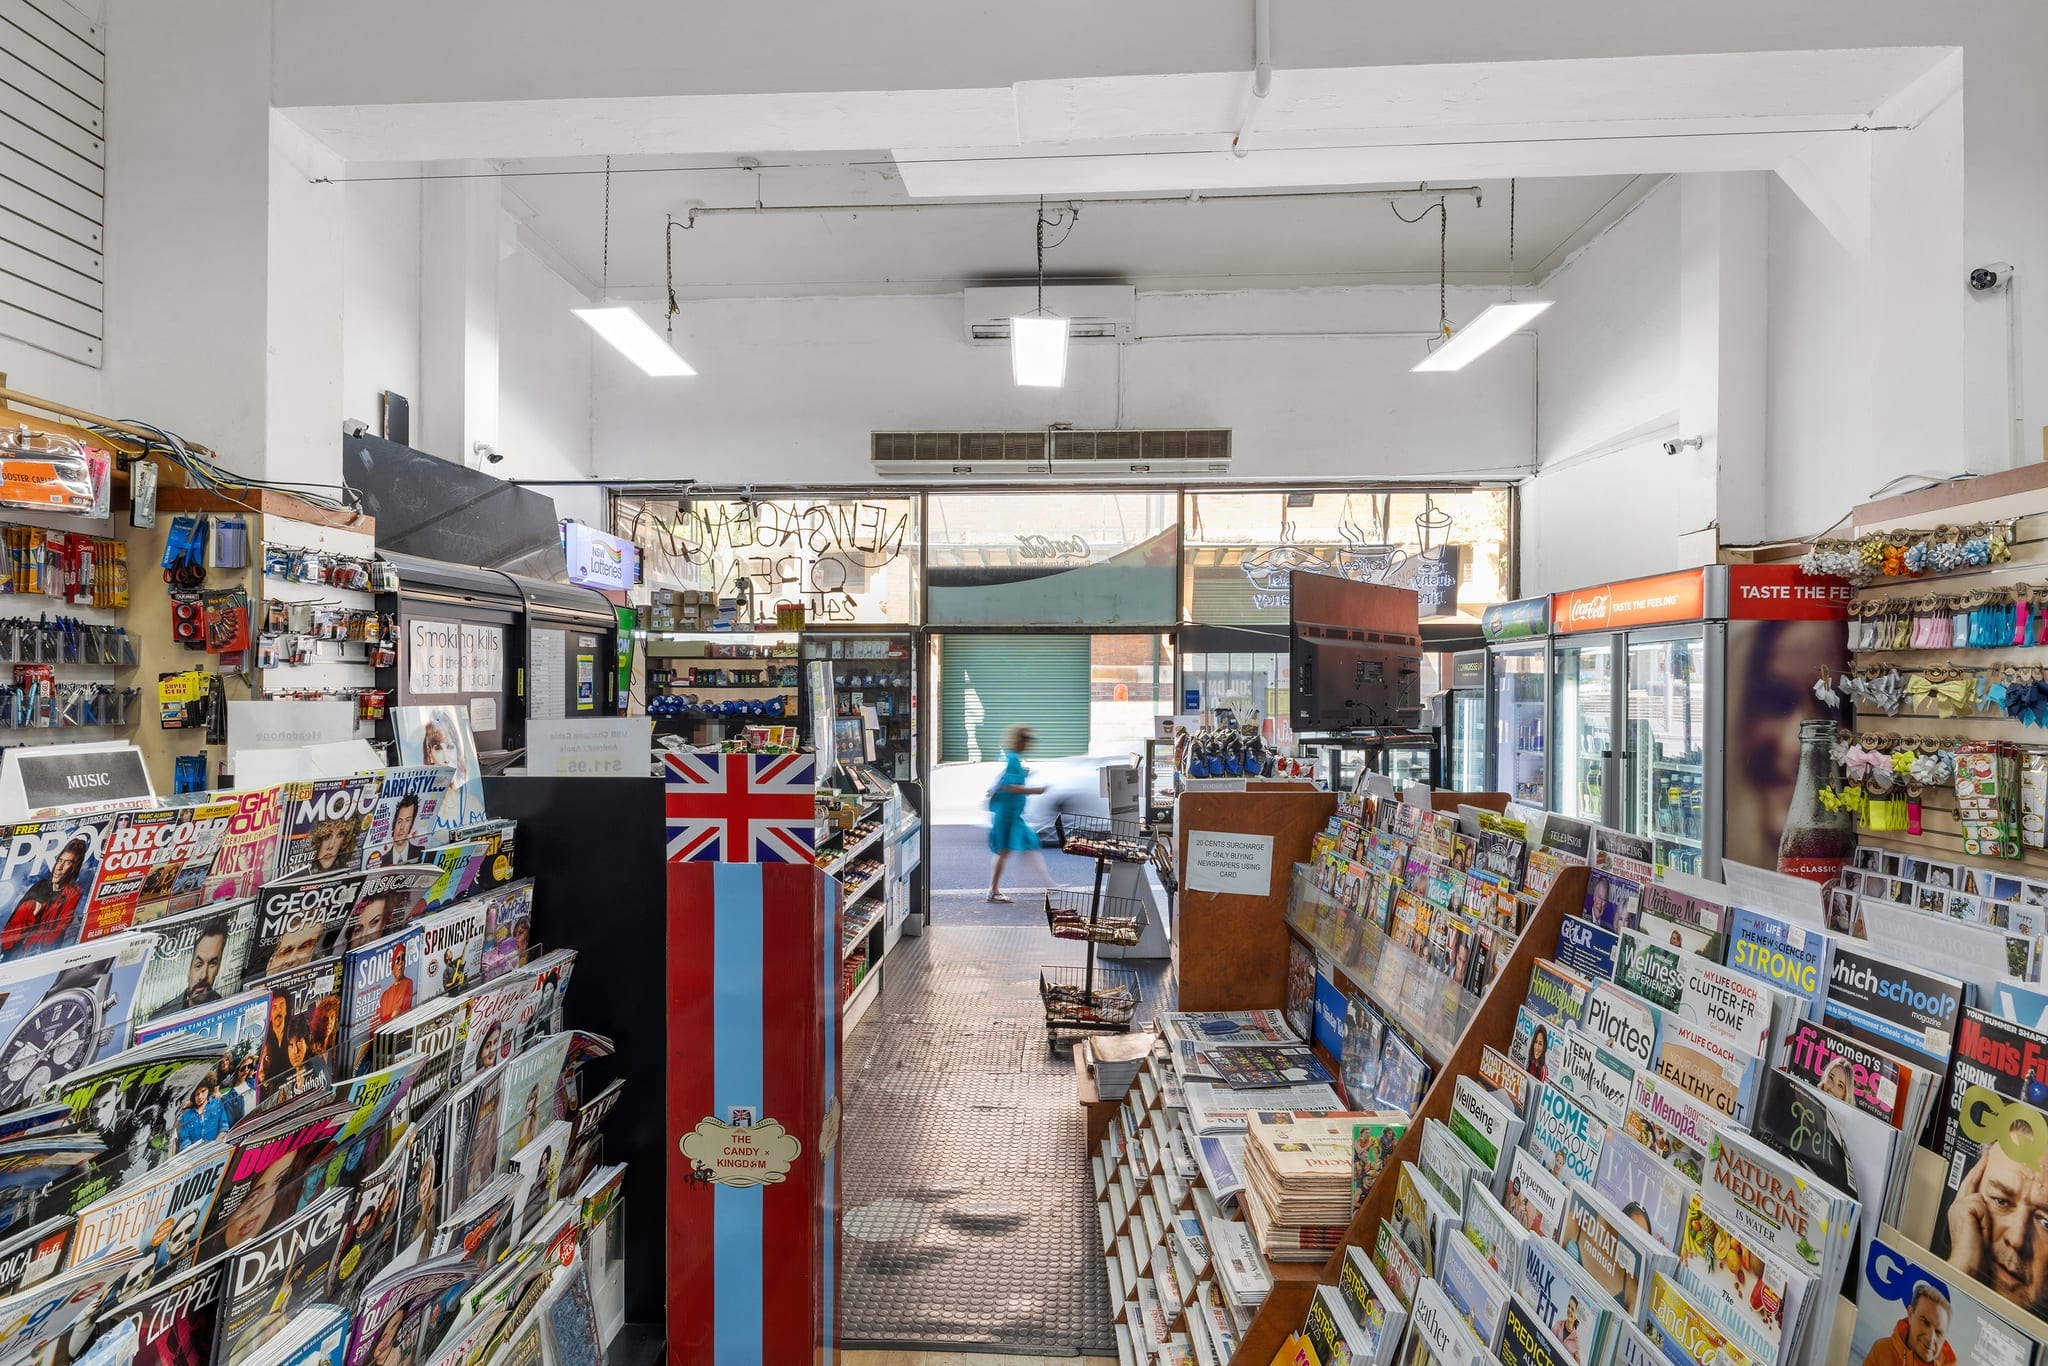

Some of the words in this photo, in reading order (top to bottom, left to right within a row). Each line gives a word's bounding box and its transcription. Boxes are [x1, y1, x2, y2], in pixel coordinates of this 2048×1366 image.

[592, 545, 605, 558] NSW
[590, 559, 622, 580] Lotteries
[1740, 586, 1791, 599] TASTE
[1794, 586, 1825, 599] THE
[1571, 595, 1607, 622] Coca-Cola
[1613, 602, 1633, 612] TASTE
[1632, 600, 1646, 610] THE
[1646, 595, 1680, 609] FEELING
[417, 626, 474, 654] Smoking
[478, 629, 498, 651] kills
[67, 773, 110, 789] MUSIC
[381, 778, 410, 799] ARRY
[295, 784, 379, 825] MOJO
[15, 824, 40, 834] FREE
[110, 819, 229, 852] RECORD
[1550, 829, 1582, 849] TELEVISION
[1212, 852, 1229, 860] ONLY
[1230, 853, 1254, 861] BUYING
[1226, 841, 1265, 851] SURCHARGE
[437, 853, 471, 874] BEATLES
[1198, 860, 1240, 870] NEWSPAPERS
[1241, 862, 1261, 871] USING
[1220, 871, 1237, 879] CARD
[1613, 856, 1624, 867] FIRE
[1626, 860, 1652, 877] STATION
[101, 880, 140, 896] Britpop
[1646, 887, 1683, 917] Vintage
[260, 903, 350, 938] MICHAEL
[1753, 919, 1765, 930] MY
[1765, 923, 1782, 937] LIFE
[1741, 929, 1756, 942] THE
[1756, 933, 1774, 947] NEW
[1774, 938, 1804, 960] SCIENCE
[1805, 953, 1816, 964] OF
[1623, 943, 1685, 991] Wellness
[1734, 941, 1817, 993] STRONG
[1626, 969, 1676, 999] EXPERIENCES
[1689, 975, 1756, 1018] CLUTTER-FR
[1703, 970, 1715, 981] MY
[1715, 973, 1731, 988] LIFE
[1731, 979, 1758, 1000] COACH
[1877, 978, 1957, 1021] school?
[1587, 998, 1651, 1060] Pilates
[1706, 1004, 1744, 1032] HOME
[1911, 1010, 1942, 1028] magazine
[1966, 1009, 1984, 1021] YOUR
[1984, 1015, 2018, 1035] SUMMER
[1514, 1031, 1528, 1048] WALK
[1568, 1039, 1592, 1061] TEEN
[1678, 1028, 1690, 1040] MY
[1690, 1032, 1707, 1049] LIFE
[1706, 1041, 1735, 1063] COACH
[1826, 1036, 1882, 1073] women's
[1959, 1017, 2021, 1077] Men's
[1483, 1047, 1501, 1068] WHAT
[1480, 1063, 1501, 1083] DON'T
[1501, 1076, 1520, 1098] TELL
[1561, 1051, 1626, 1108] Mindfulness
[1636, 1079, 1652, 1104] The
[1655, 1056, 1716, 1104] HEALTHY
[1715, 1094, 1745, 1121] GUT
[1955, 1060, 1998, 1092] SHRINK
[354, 1082, 402, 1106] BEATLES
[1455, 1083, 1494, 1134] WellBeing
[1541, 1084, 1590, 1142] HOME
[1959, 1084, 2048, 1172] GQ
[724, 1147, 760, 1156] CANDY
[731, 1135, 752, 1144] THE
[1534, 1125, 1592, 1184] HANDBOOK
[1536, 1109, 1598, 1169] WORKOUT
[1515, 1160, 1556, 1210] Peppermint
[1718, 1142, 1809, 1216] NATURAL
[77, 1189, 170, 1262] DEPECHE
[166, 1161, 225, 1218] MODE
[1712, 1165, 1809, 1236] MEDICINE
[1735, 1208, 1744, 1222] IS
[1744, 1212, 1776, 1243] WATER
[234, 1203, 344, 1298] DANCE
[1583, 1239, 1616, 1278] manual
[1526, 1245, 1556, 1300] WALK
[1536, 1290, 1559, 1331] FIT
[1721, 1289, 1734, 1305] The
[1414, 1295, 1450, 1354] gather
